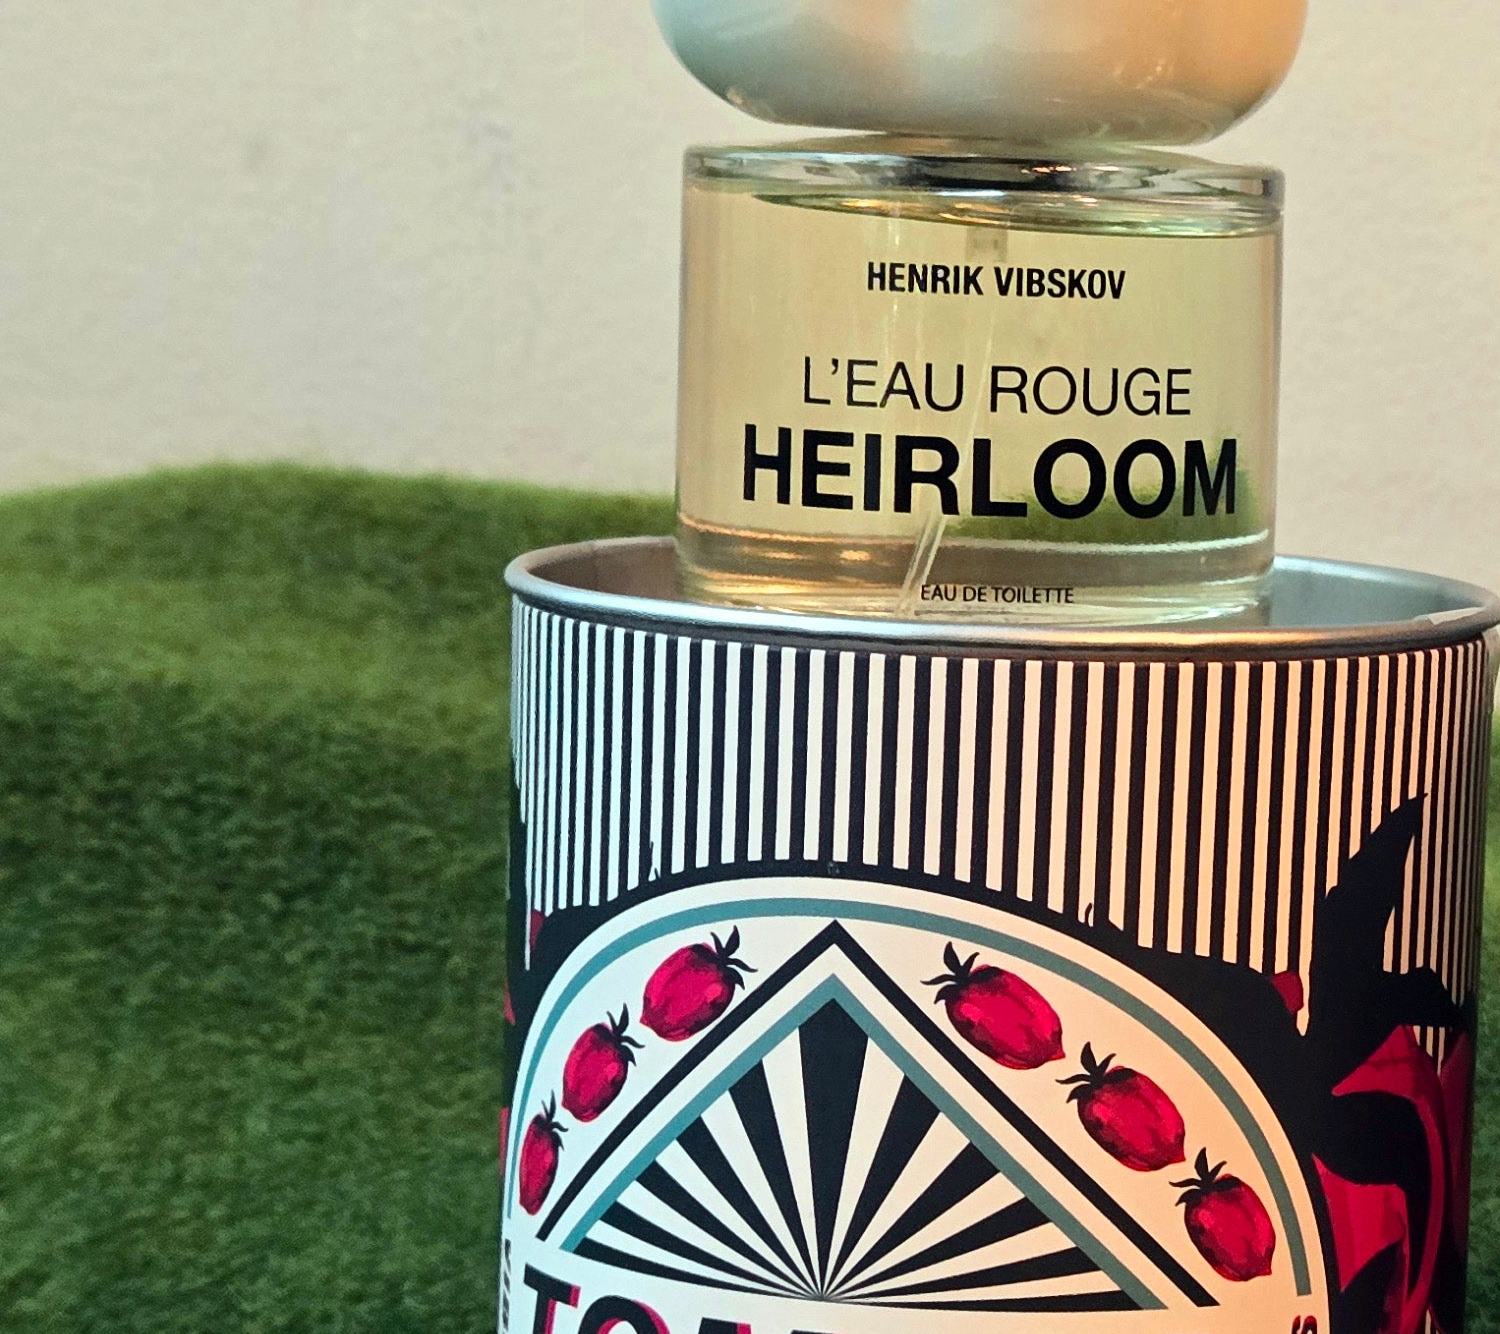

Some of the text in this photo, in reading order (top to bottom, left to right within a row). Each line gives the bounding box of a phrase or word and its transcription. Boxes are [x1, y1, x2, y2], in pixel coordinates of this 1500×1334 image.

[867, 261, 1126, 300] HENRIK VIBSKOV
[803, 355, 1193, 416] L'EAU ROUGE
[742, 423, 1237, 520] HEIRLOOM
[920, 584, 1075, 604] EAU DE TOILETTE
